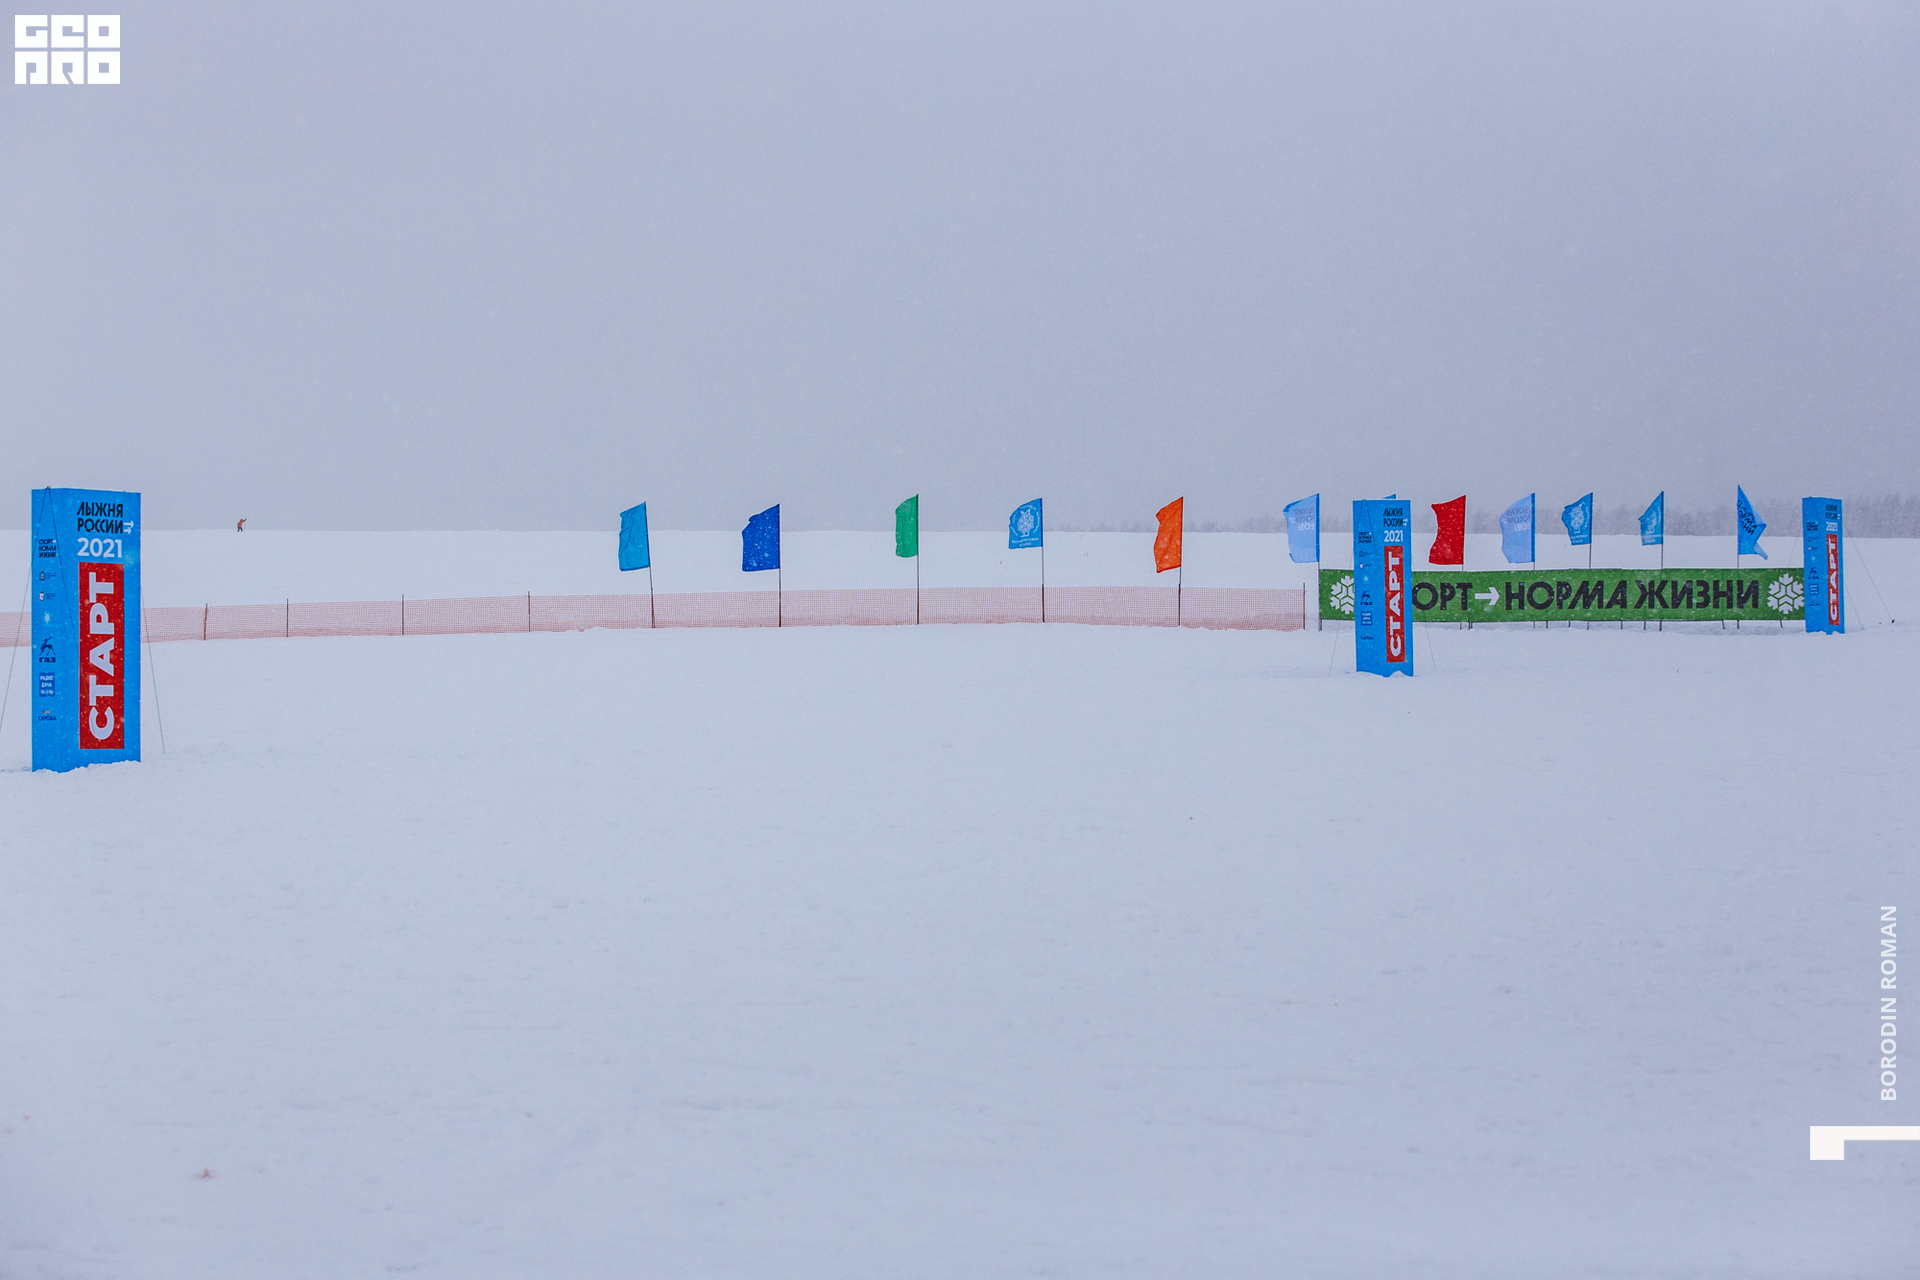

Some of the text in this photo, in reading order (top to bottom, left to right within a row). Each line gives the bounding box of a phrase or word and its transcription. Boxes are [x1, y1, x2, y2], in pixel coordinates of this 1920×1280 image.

[76, 501, 123, 518] ЛЫЖНЯ
[77, 517, 123, 534] РОССИИ
[1384, 530, 1404, 542] 2021
[77, 537, 122, 558] 2021
[1828, 538, 1838, 621] СТАРТ
[1388, 551, 1401, 657] СТАРТ
[1505, 580, 1627, 611] НОРМА
[1634, 579, 1759, 609] ЖИЗНИ
[88, 572, 115, 740] СТАРТ
